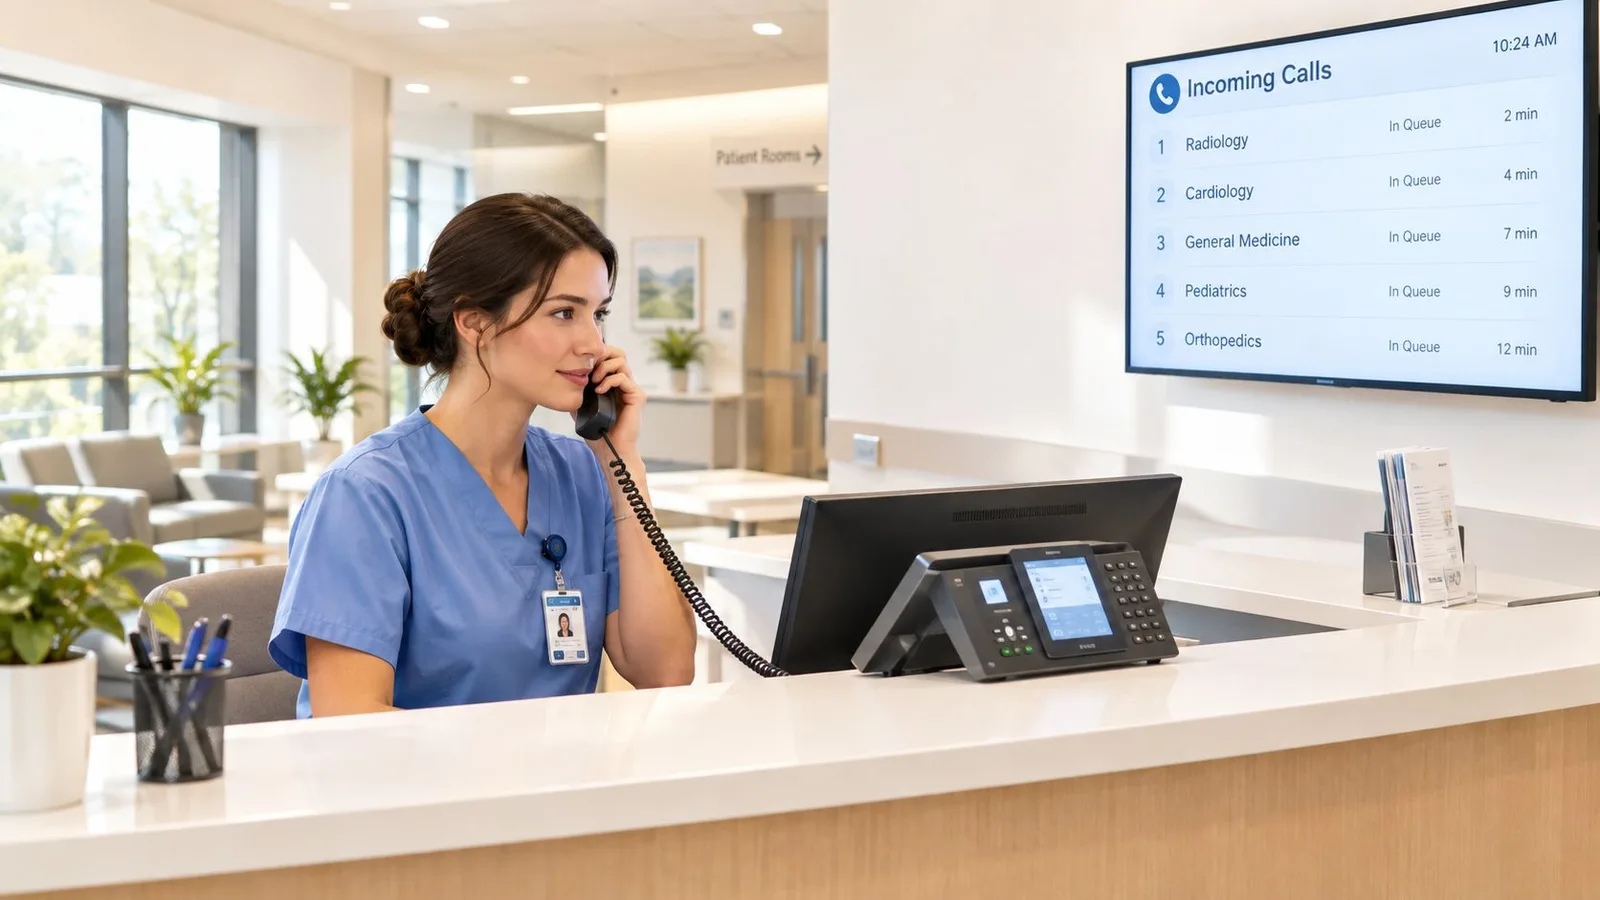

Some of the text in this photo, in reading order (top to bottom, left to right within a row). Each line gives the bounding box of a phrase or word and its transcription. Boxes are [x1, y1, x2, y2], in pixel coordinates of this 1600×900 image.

[1493, 32, 1556, 52] 10:24 AM
[1188, 60, 1331, 97] Incoming Calls
[1158, 108, 1537, 155] 1 Radiology In Queue 2 min
[716, 148, 801, 165] Patient Rooms
[1156, 168, 1537, 203] 2 Cardiology In Queue 4 min
[1156, 227, 1537, 250] 3 General Medicine In Queue 7 min
[1155, 283, 1537, 298] 4 Pediatrics In Queue 9 min
[1156, 331, 1537, 355] 5 Orthopedics In Queue 12 min
